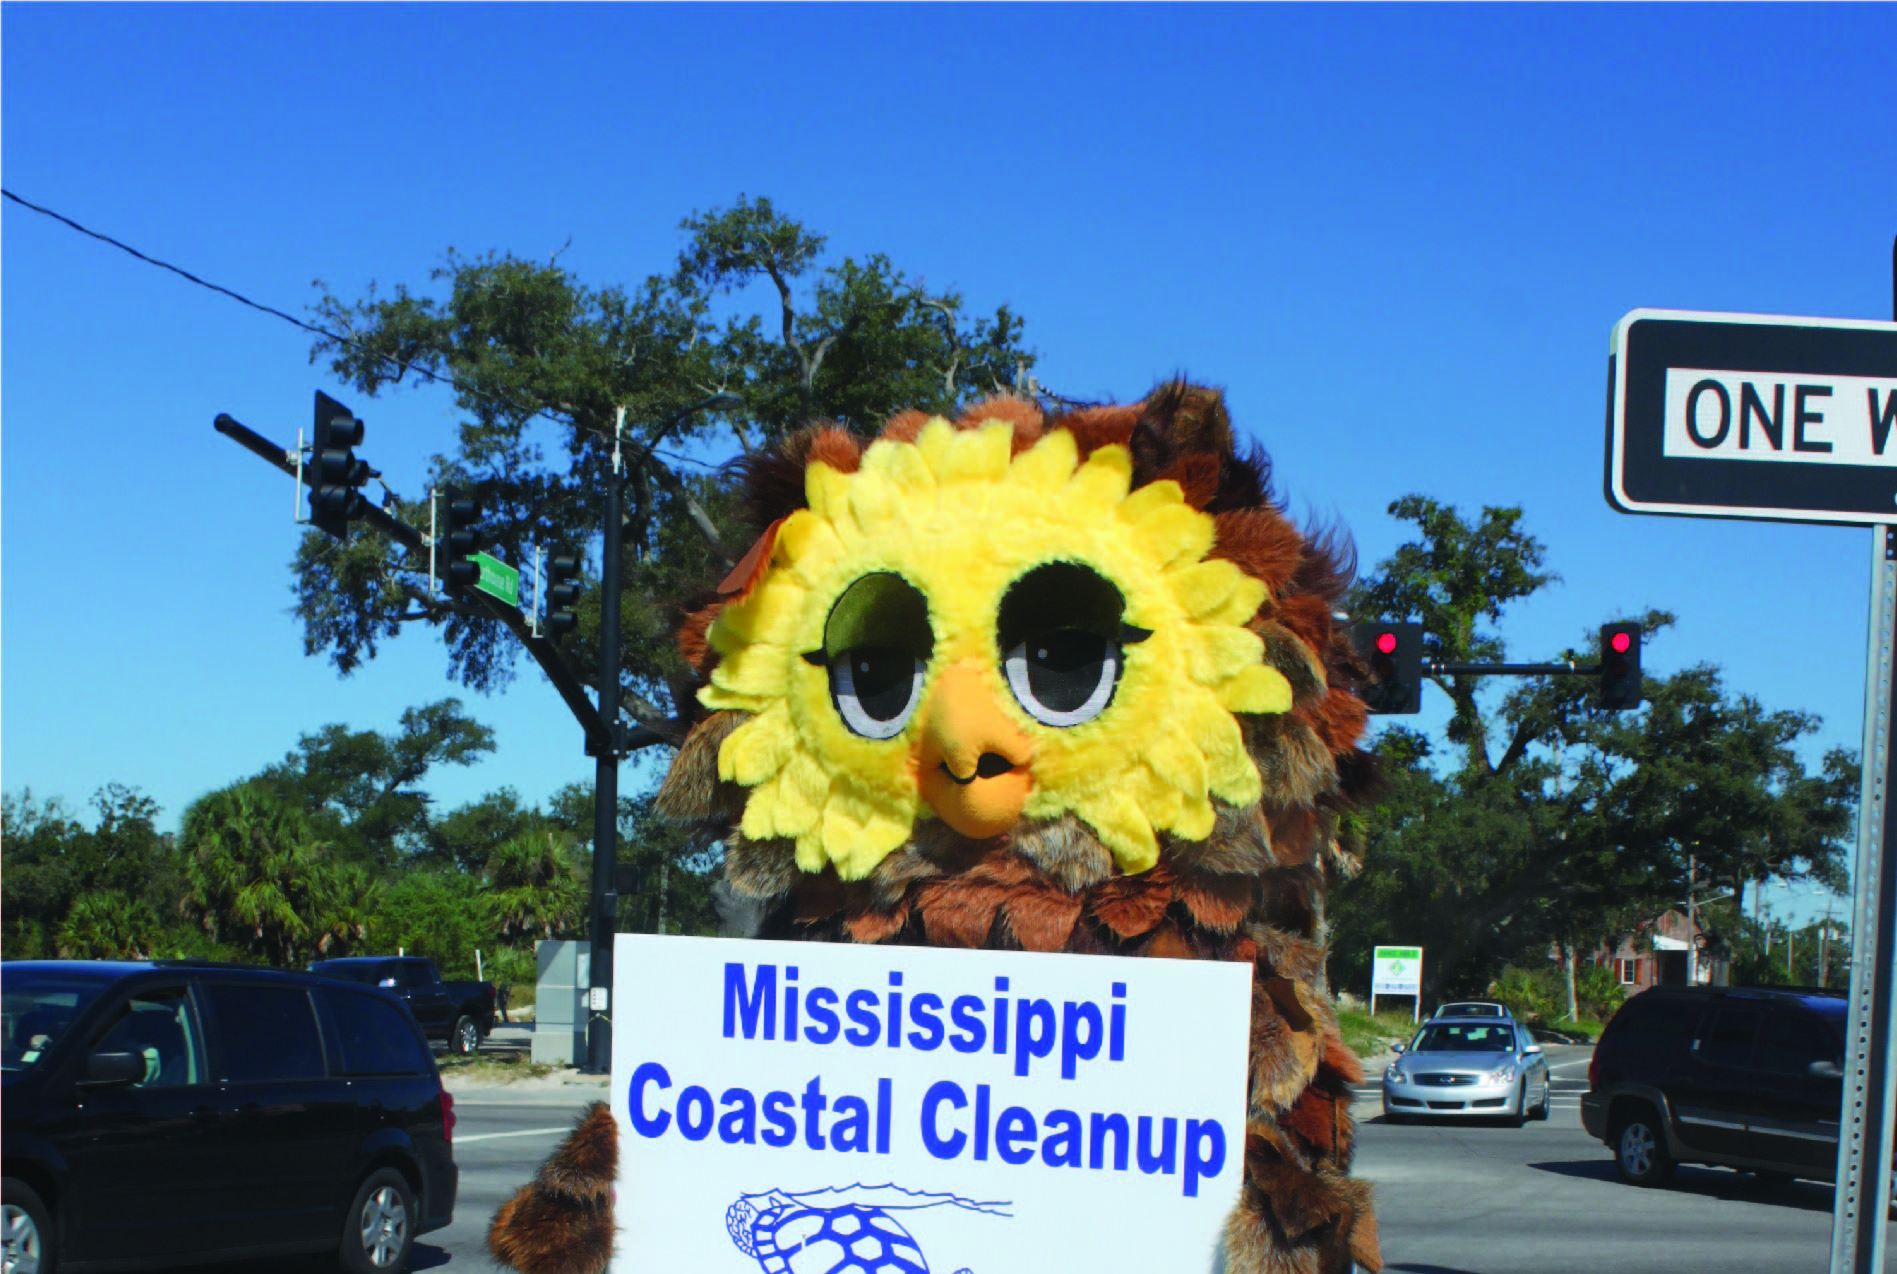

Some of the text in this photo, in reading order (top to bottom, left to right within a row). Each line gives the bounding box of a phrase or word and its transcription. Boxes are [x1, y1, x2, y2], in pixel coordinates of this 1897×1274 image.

[1685, 379, 1833, 453] ONE
[722, 962, 1127, 1081] Mississippi
[628, 1061, 1227, 1198] Coastal Cleanup
